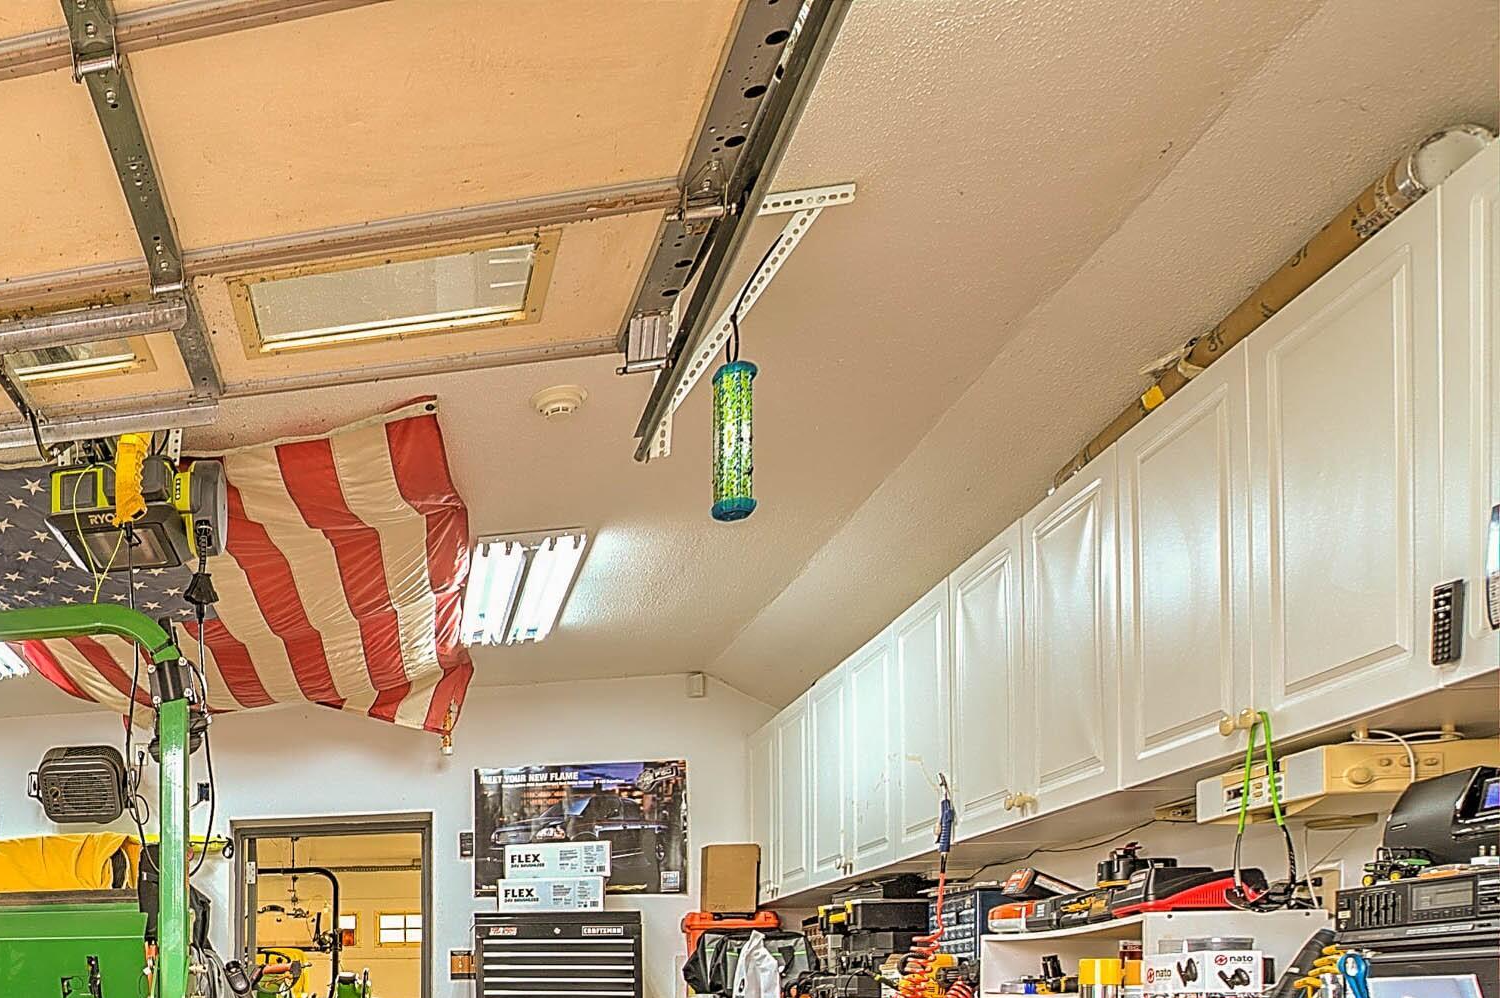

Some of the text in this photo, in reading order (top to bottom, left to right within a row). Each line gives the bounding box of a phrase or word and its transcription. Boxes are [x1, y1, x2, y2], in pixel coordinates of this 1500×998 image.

[88, 512, 117, 525] RYO
[479, 775, 503, 785] MEET
[503, 774, 526, 783] YOUR
[528, 772, 548, 782] NEW
[549, 771, 579, 781] FLAME
[510, 853, 541, 864] FLEX
[503, 888, 534, 898] FLEX
[583, 927, 622, 935] CRAFTSMAN
[1229, 954, 1254, 962] nato
[1155, 967, 1172, 978] nato
